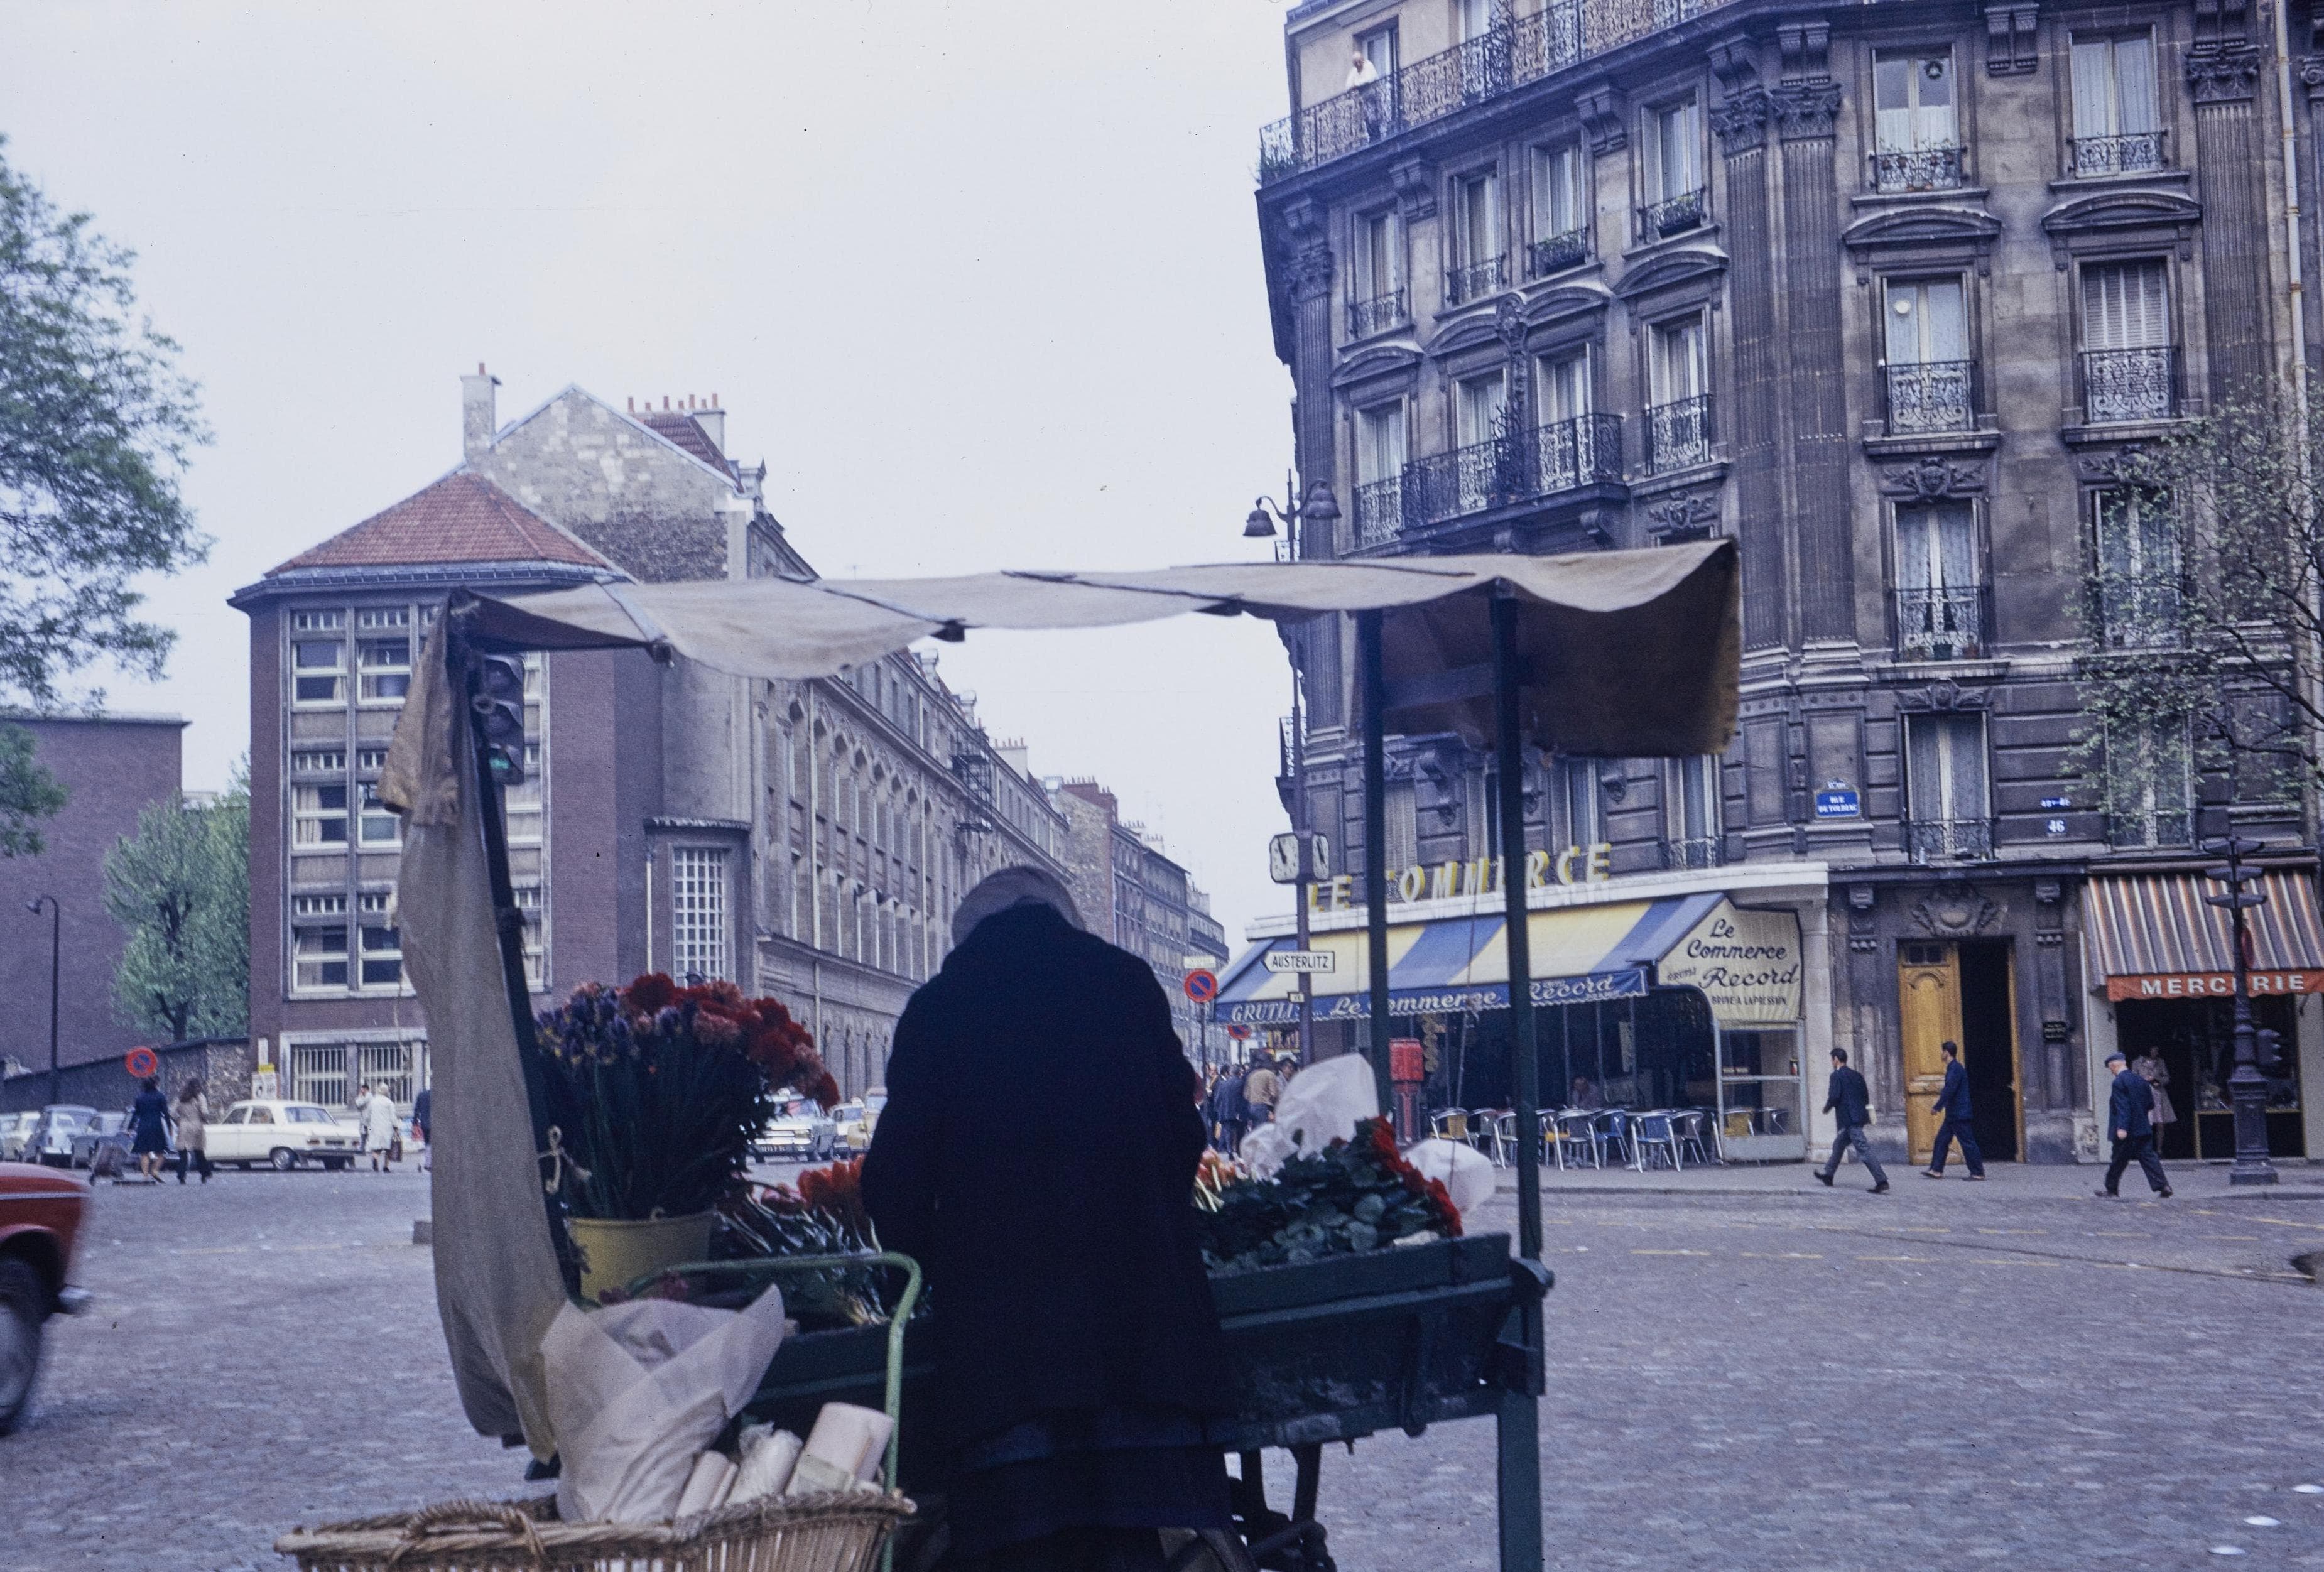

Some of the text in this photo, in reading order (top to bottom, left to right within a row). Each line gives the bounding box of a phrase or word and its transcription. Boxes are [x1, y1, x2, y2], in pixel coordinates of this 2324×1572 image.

[2048, 819, 2065, 833] 46
[1307, 843, 1612, 912] LE OMMRCE
[1710, 919, 1734, 938] Le
[1687, 939, 1787, 960] Commerce
[1273, 955, 1328, 968] AUSTERLITZ
[1698, 963, 1799, 989] Record
[1330, 996, 1362, 1016] Le
